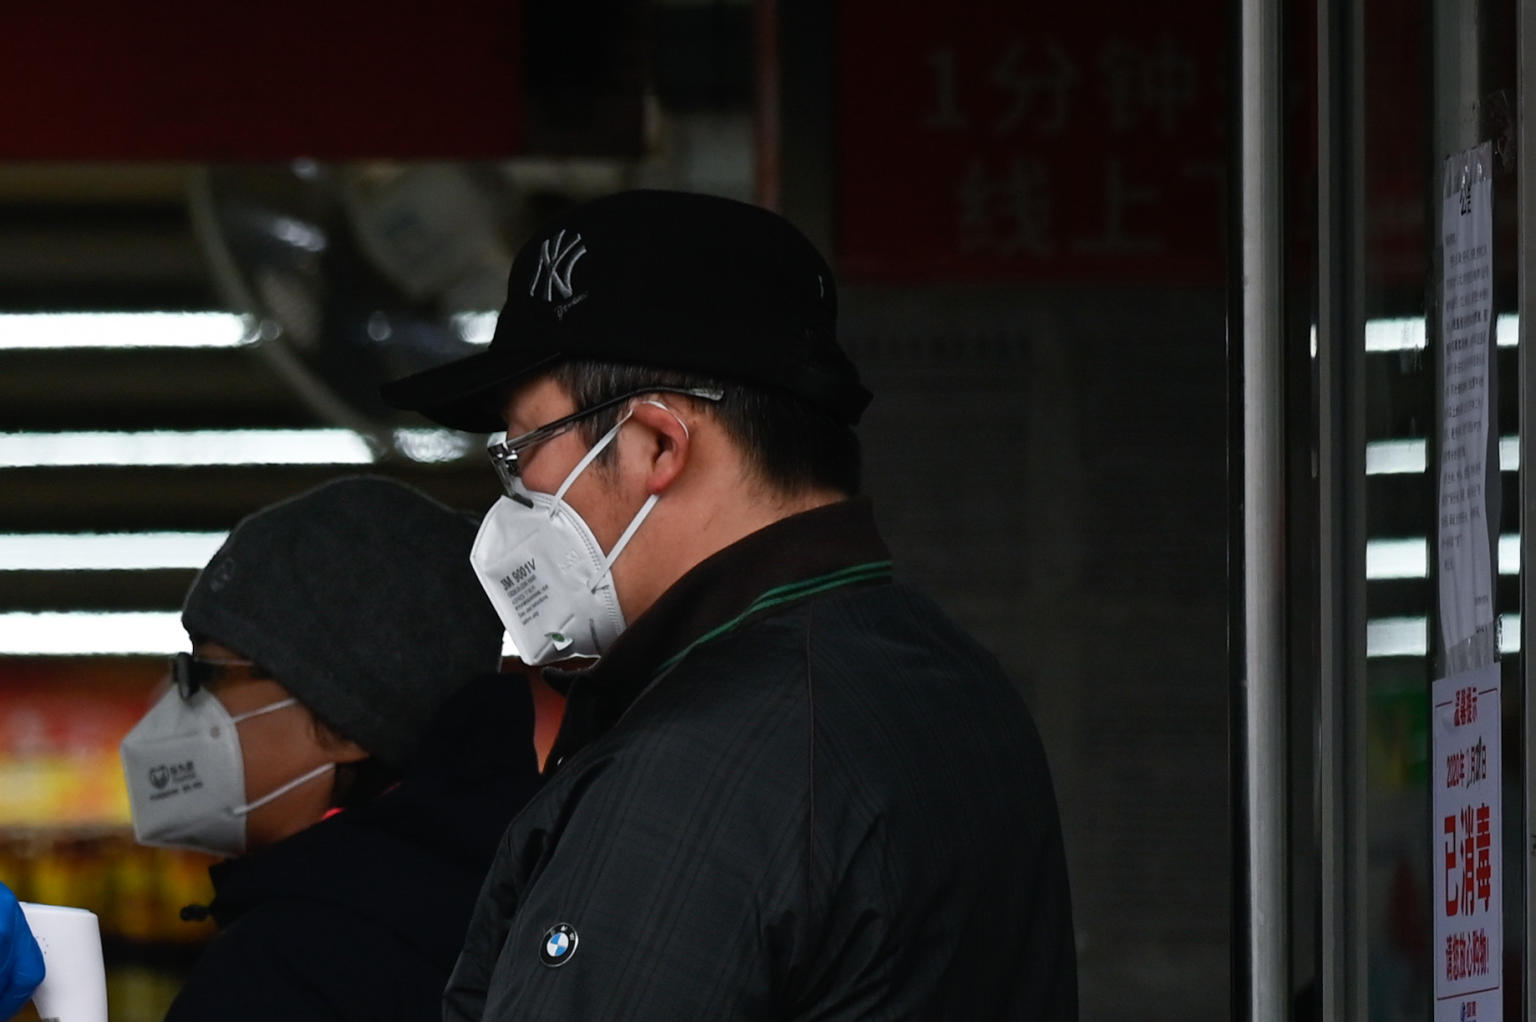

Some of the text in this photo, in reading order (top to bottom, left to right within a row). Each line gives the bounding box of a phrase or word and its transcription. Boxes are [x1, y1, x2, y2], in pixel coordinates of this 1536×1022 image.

[919, 32, 1226, 138] 1分钟
[530, 229, 587, 302] NY
[1444, 802, 1492, 917] 已消毒
